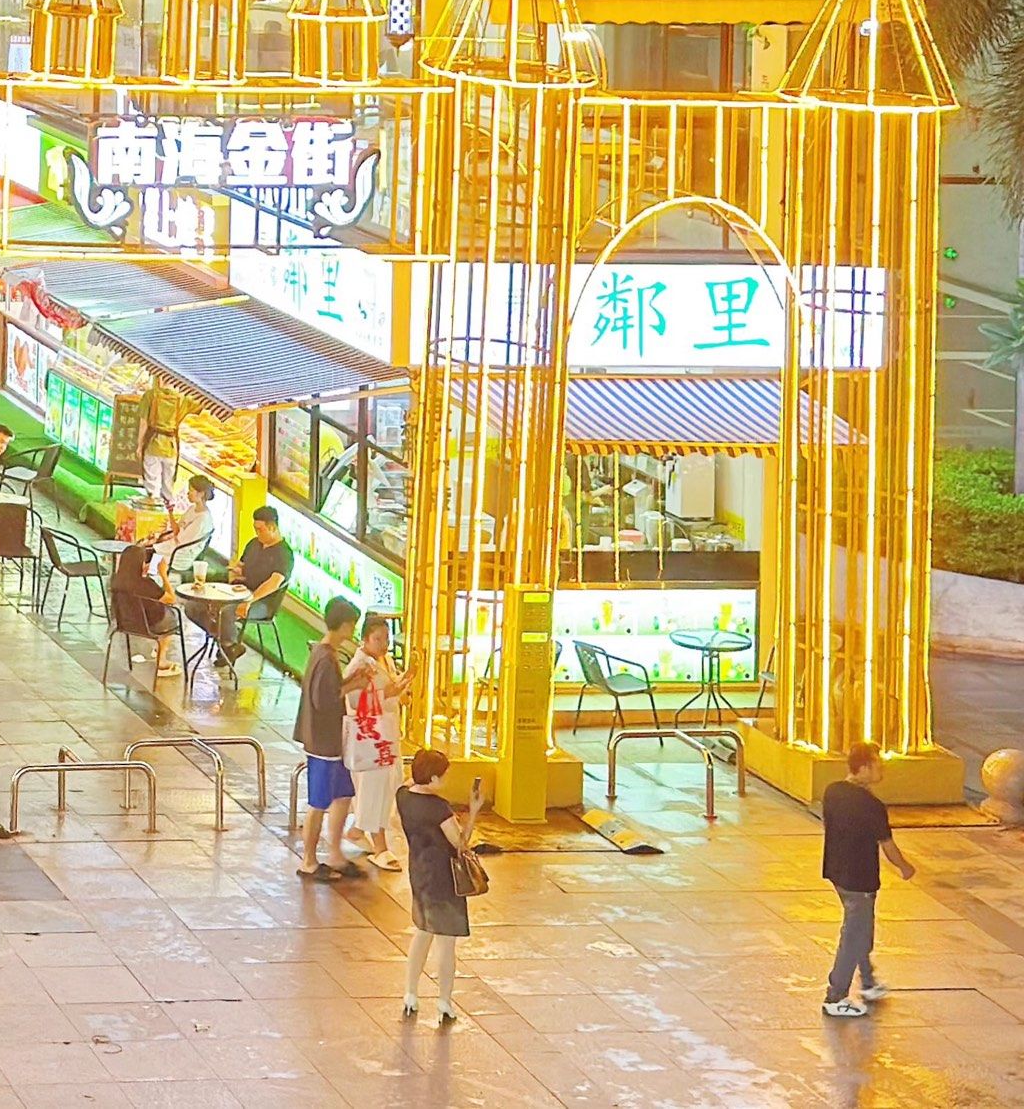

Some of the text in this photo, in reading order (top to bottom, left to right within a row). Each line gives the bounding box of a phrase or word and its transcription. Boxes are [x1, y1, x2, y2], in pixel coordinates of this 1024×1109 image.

[95, 118, 357, 185] 南海金街
[590, 272, 771, 359] 鄰里
